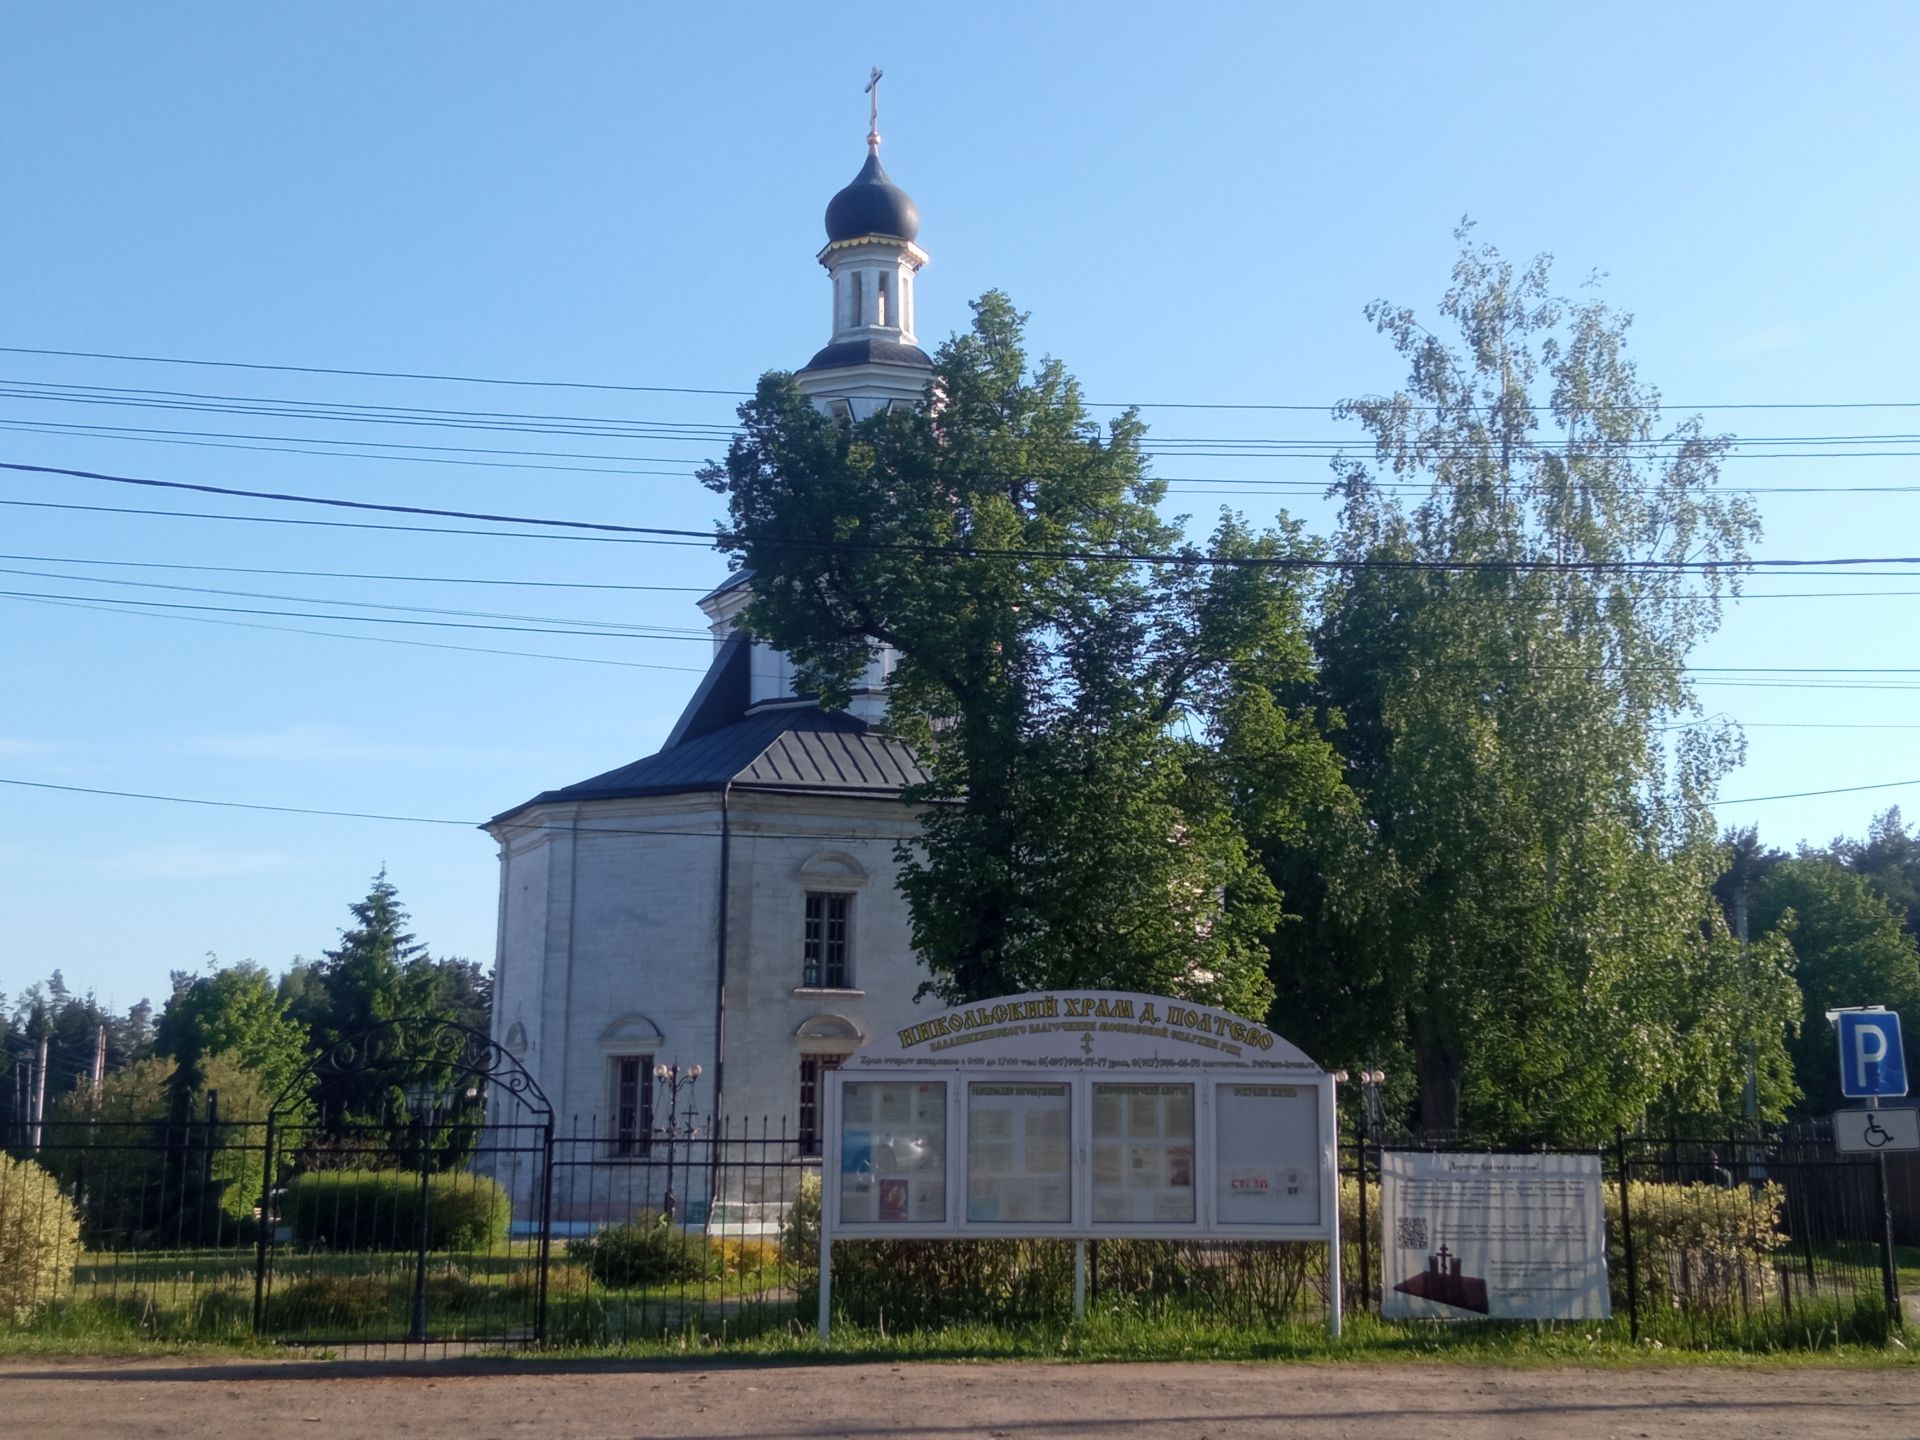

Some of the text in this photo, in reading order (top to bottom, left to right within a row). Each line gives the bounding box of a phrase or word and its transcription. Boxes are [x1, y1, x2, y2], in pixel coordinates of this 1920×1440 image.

[897, 995, 1059, 1049] НИКОЛЬСКИЙ
[1063, 998, 1136, 1019] ХРАМ
[1166, 1005, 1274, 1052] ПОЛТЕВО
[1855, 1025, 1888, 1087] P
